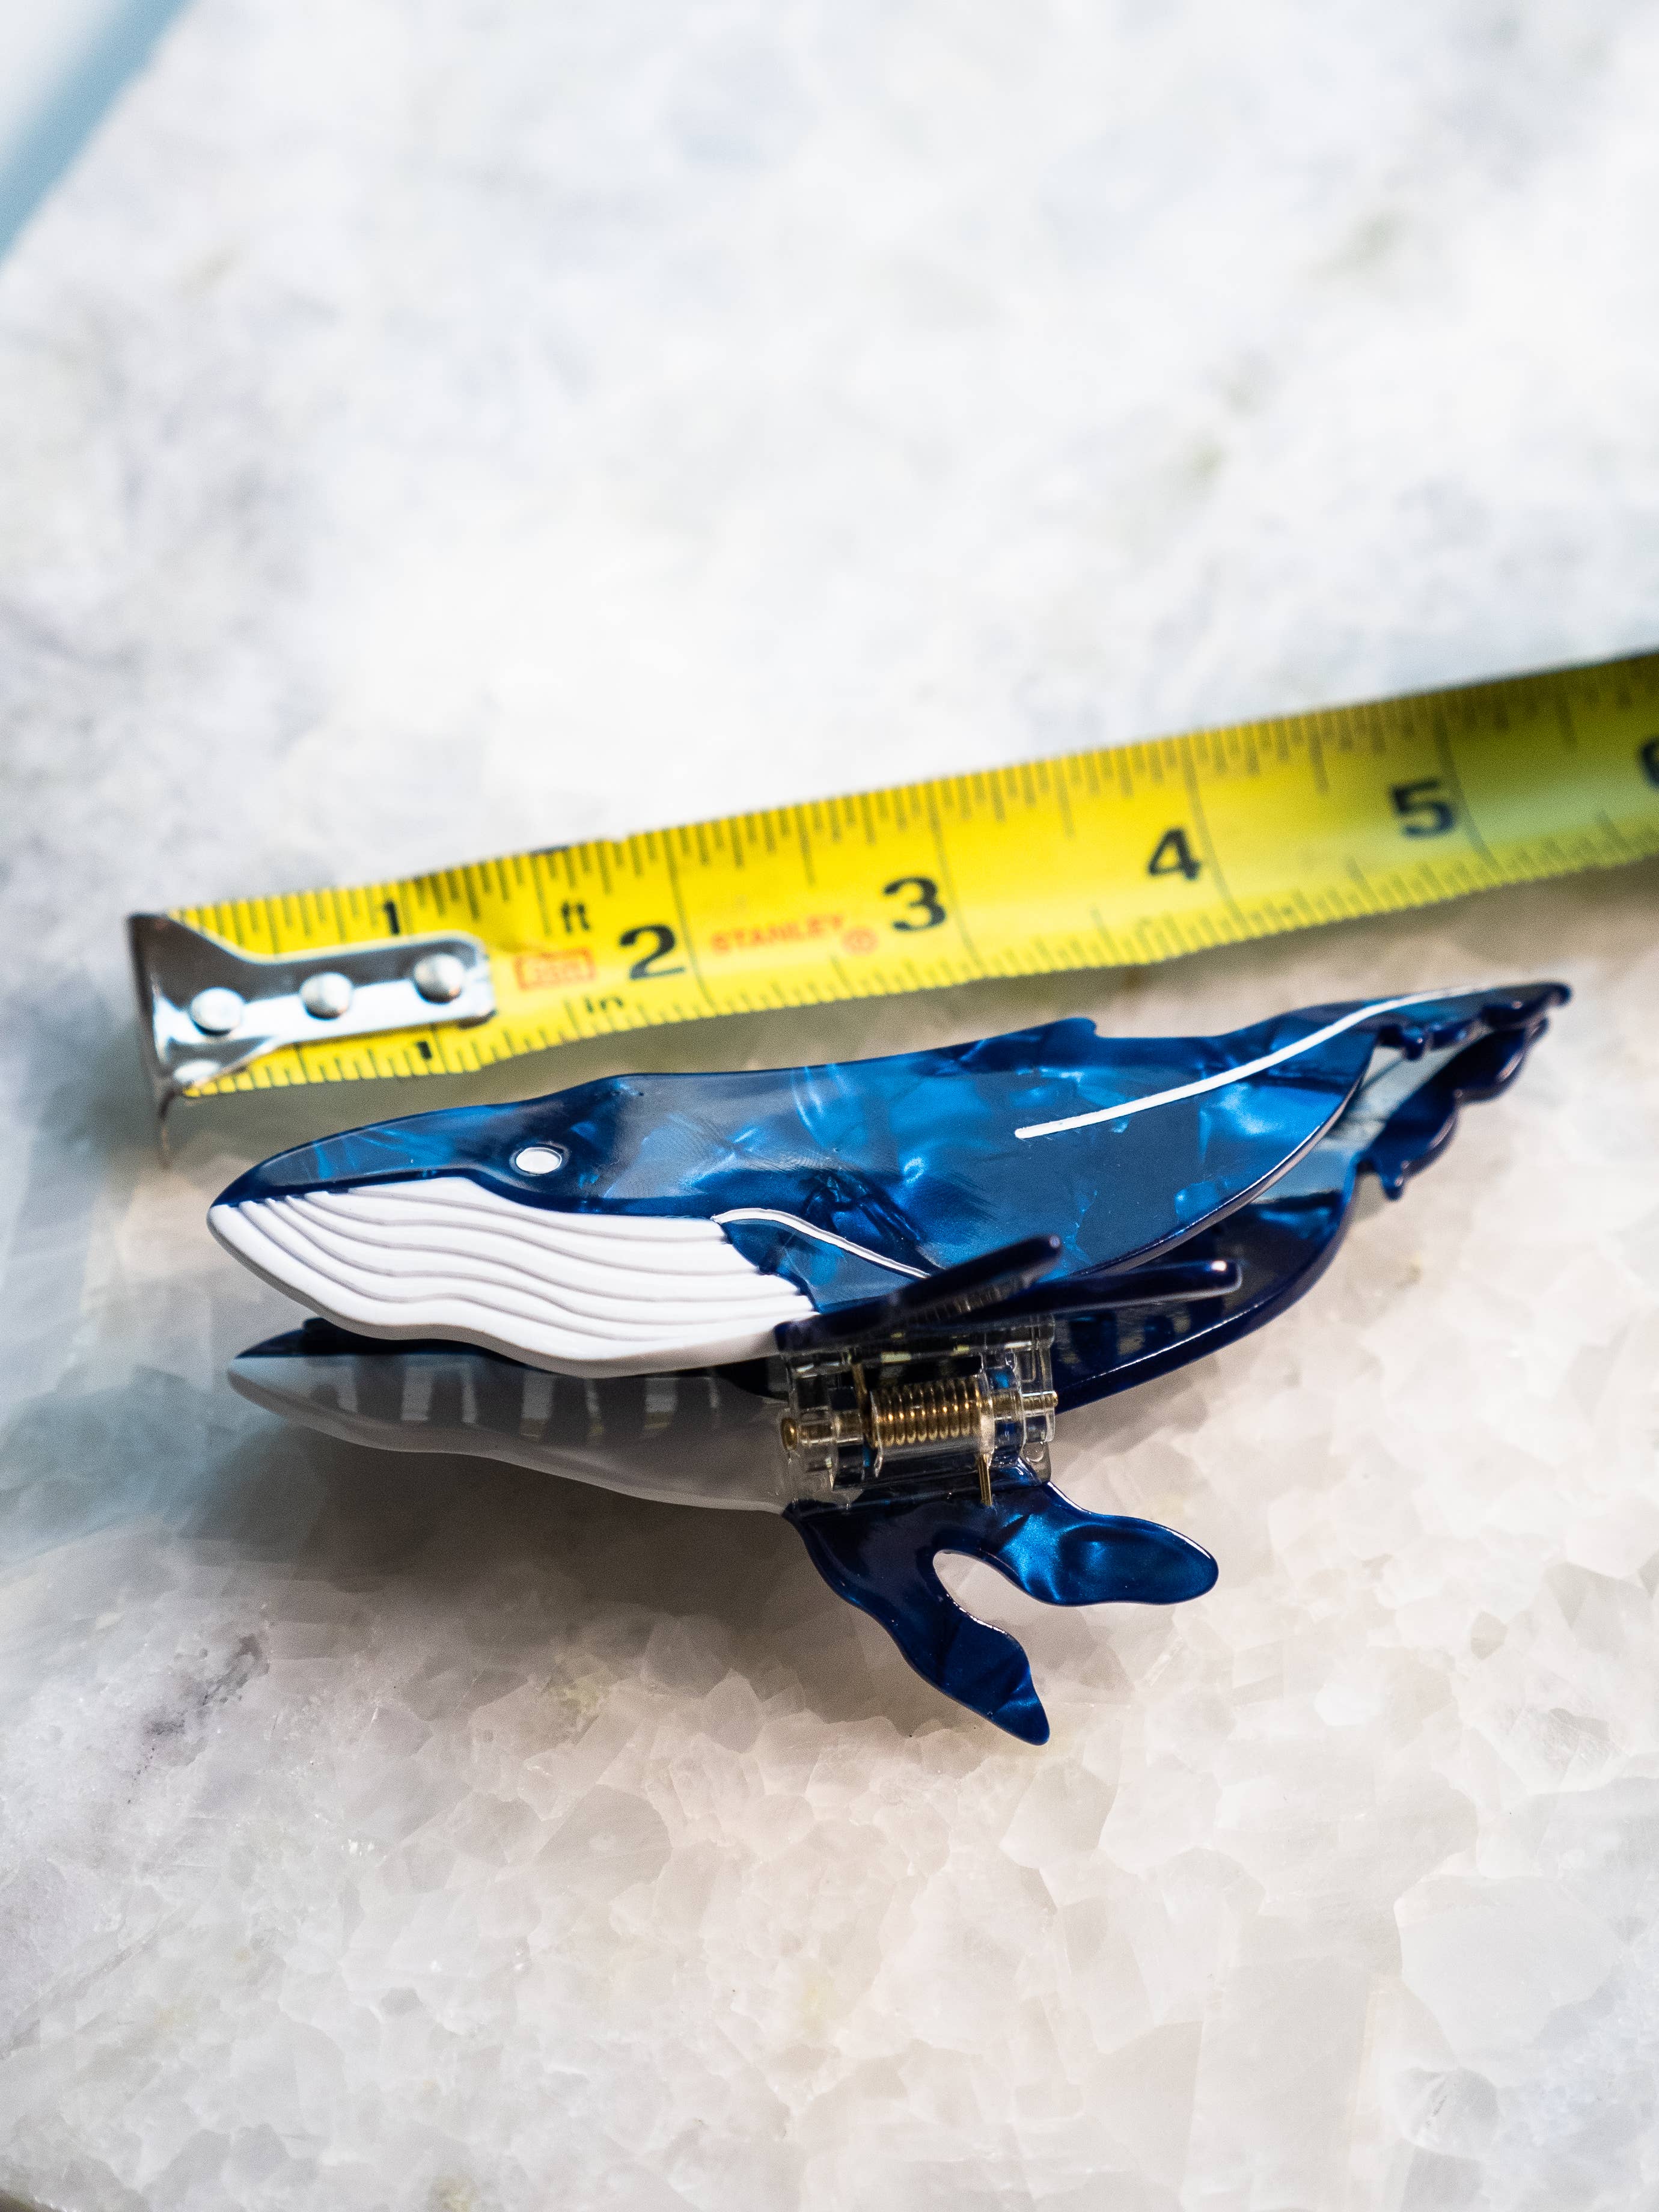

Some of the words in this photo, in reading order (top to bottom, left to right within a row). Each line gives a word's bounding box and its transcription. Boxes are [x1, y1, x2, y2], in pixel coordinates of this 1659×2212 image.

[1390, 778, 1457, 838] 5
[1147, 827, 1202, 881] 4
[383, 900, 400, 935] 1
[882, 875, 947, 933] 3
[619, 923, 686, 981] 2
[709, 914, 843, 957] STANLEY
